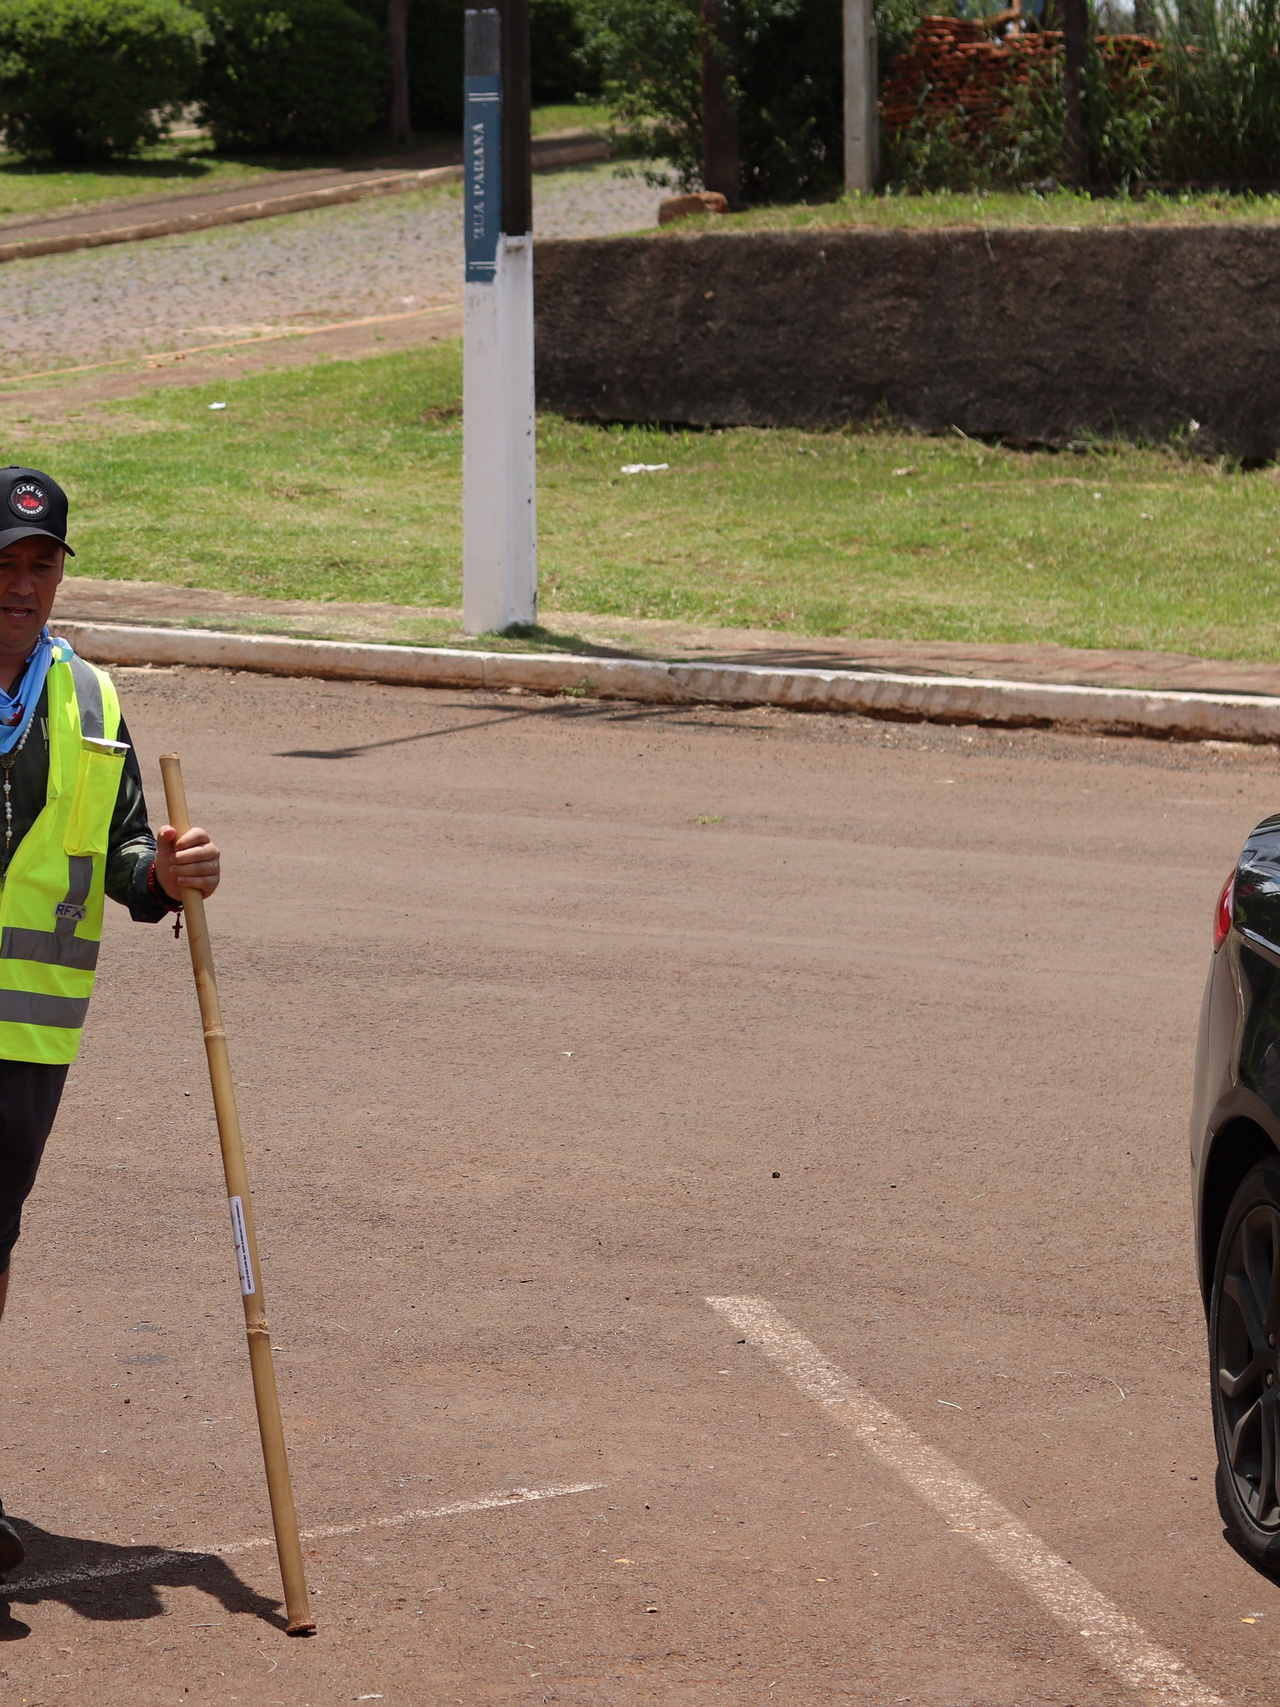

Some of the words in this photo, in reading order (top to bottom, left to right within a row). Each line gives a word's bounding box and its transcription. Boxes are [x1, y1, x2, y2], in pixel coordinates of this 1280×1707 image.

[473, 201, 485, 239] RUA
[16, 485, 35, 495] CASE
[55, 903, 86, 919] RFX
